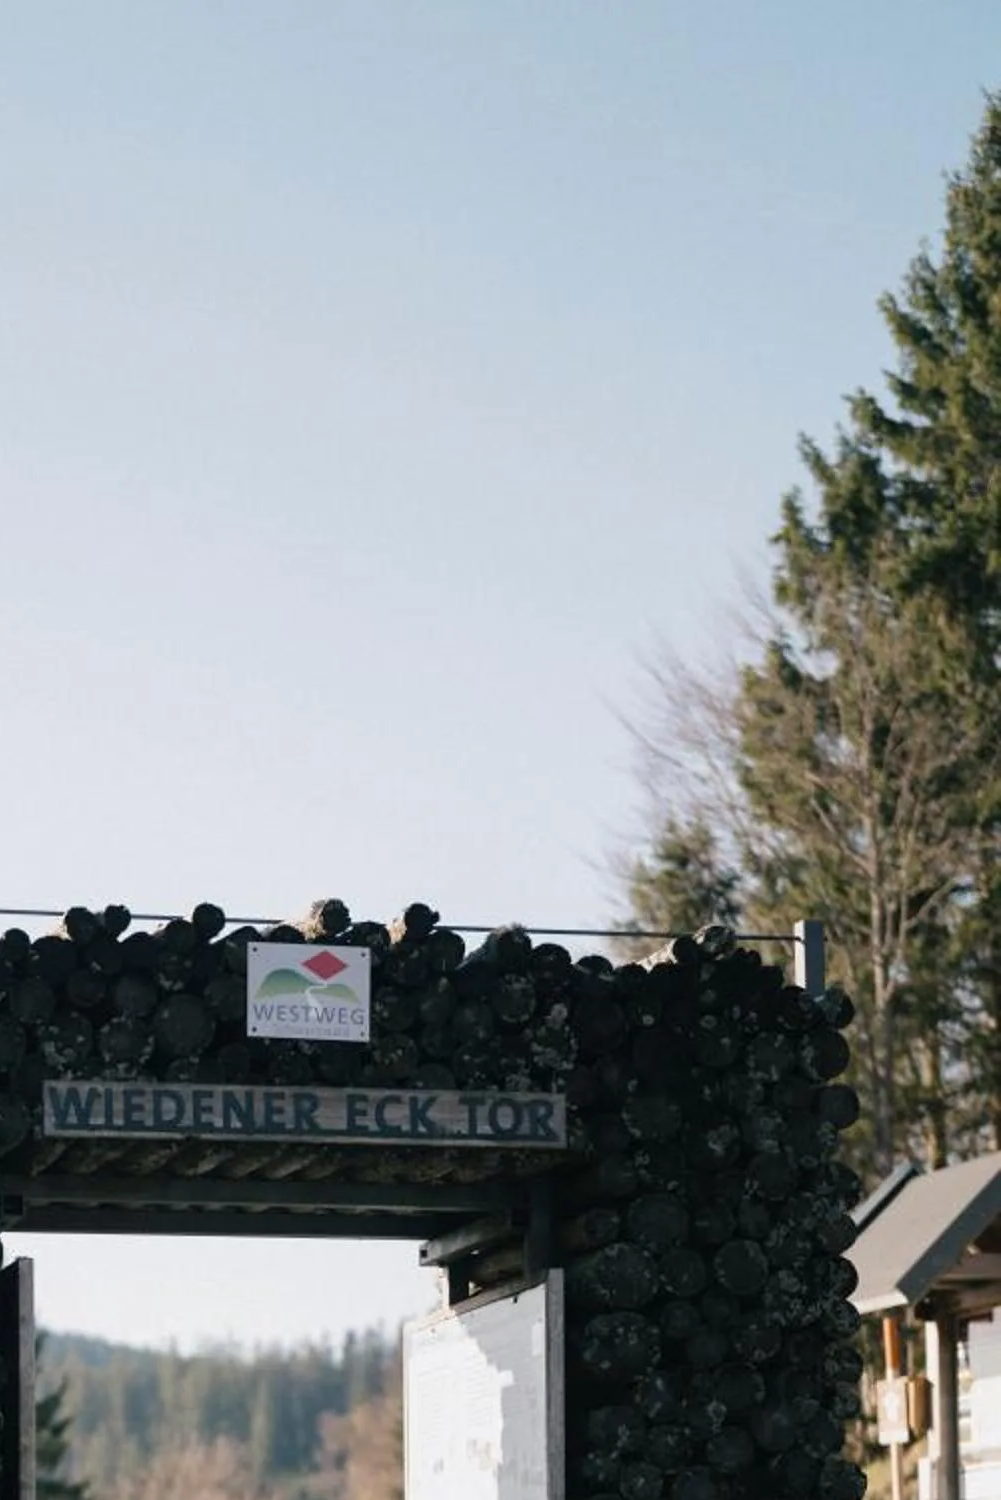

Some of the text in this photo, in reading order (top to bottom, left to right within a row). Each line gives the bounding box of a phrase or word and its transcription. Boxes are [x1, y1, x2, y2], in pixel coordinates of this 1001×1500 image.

[252, 1003, 364, 1025] WESTWEG
[49, 1086, 559, 1141] WIEDENER ECK TOR
